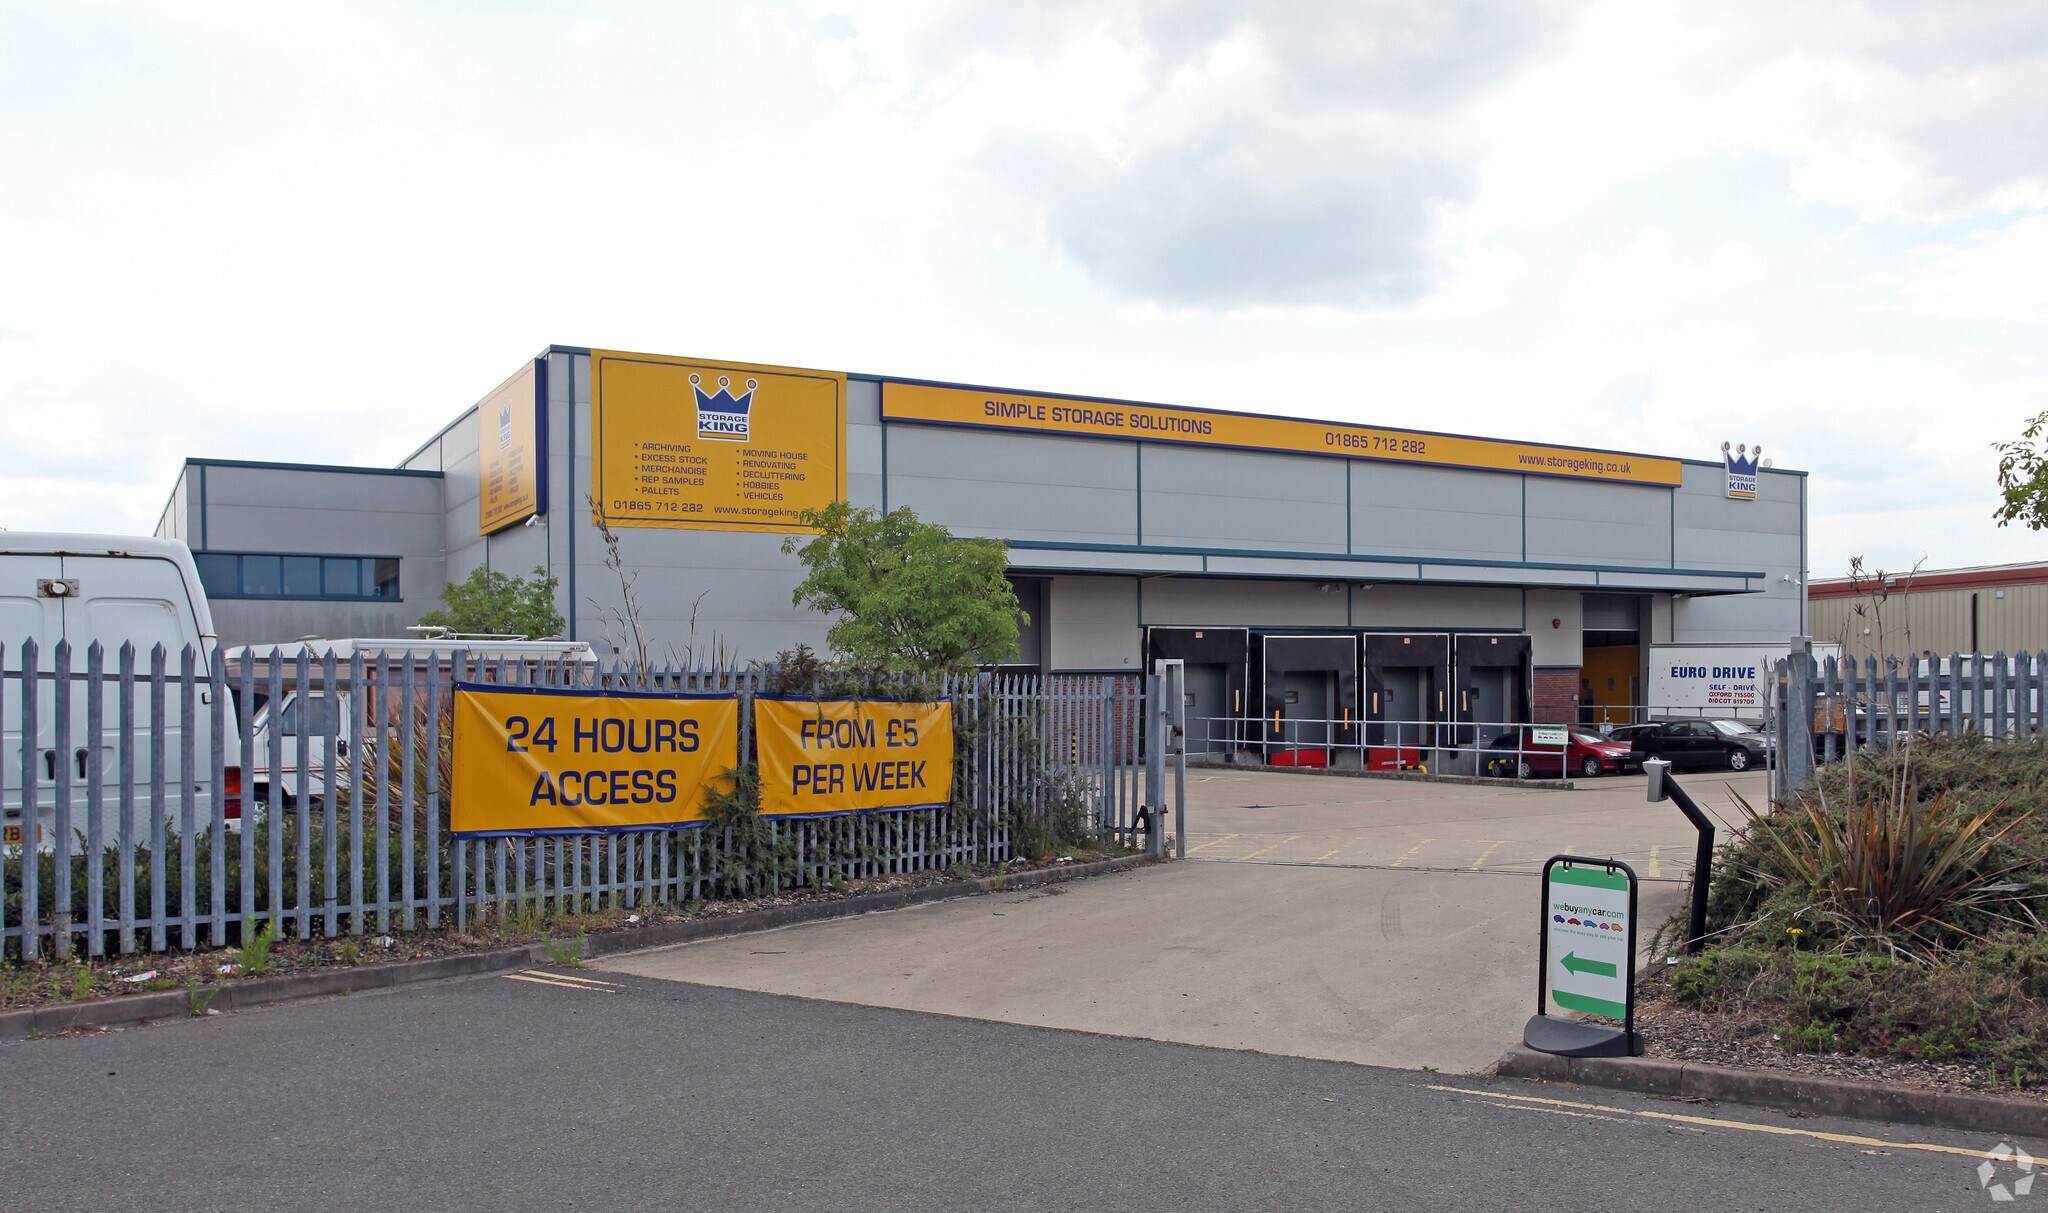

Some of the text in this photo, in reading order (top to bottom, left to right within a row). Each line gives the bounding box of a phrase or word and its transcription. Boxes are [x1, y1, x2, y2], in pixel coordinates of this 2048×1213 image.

[699, 413, 748, 422] STORAGE
[984, 400, 1212, 435] SIMPLE STORAGE SOLUTIONS
[699, 420, 748, 432] KING
[641, 442, 691, 453] ARCHIVING
[1325, 432, 1426, 454] 01865 712 282
[641, 453, 708, 465] EXCESS STOCK
[742, 449, 808, 460] MOVING HOUSE
[641, 464, 707, 475] MERCHANDISE
[742, 460, 797, 470] RENOVATING
[1518, 454, 1631, 474] www.storageking.co.uk
[641, 475, 705, 486] REP SAMPLES
[742, 470, 806, 481] DECLUTTERING
[1729, 474, 1756, 483] STORAGE
[641, 486, 680, 496] PALLETS
[742, 481, 780, 490] HOBBIES
[1729, 481, 1756, 491] KING
[743, 491, 784, 501] VEHICLES
[613, 500, 799, 519] 01865 712 282 www.storageking
[1671, 667, 1755, 678] EURO DRIVE
[505, 715, 700, 753] 24 HOURS
[800, 718, 919, 750] FROM £5
[792, 759, 927, 796] PER WEEK
[529, 769, 677, 807] ACCESS
[1553, 903, 1624, 919] webuyanycar.com
